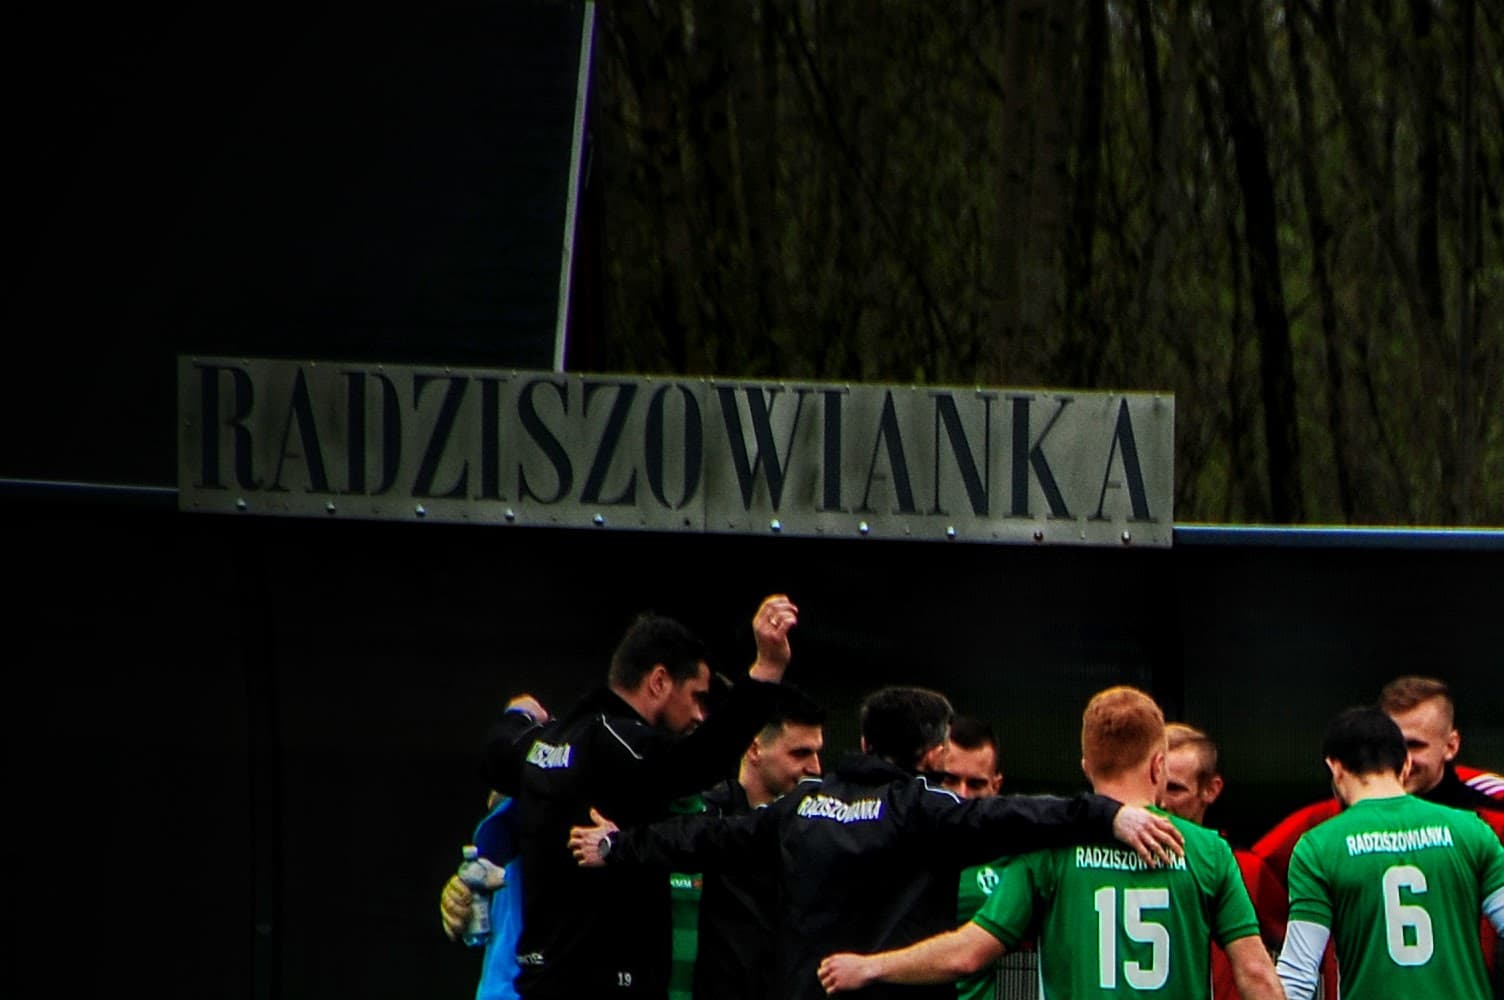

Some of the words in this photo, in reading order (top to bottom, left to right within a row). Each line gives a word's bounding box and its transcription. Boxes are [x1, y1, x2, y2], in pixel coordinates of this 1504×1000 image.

[191, 363, 1160, 523] RADZISZOWIANKA
[1345, 825, 1454, 857] RADZISZOWIANKA
[1094, 884, 1171, 991] 15
[1382, 864, 1434, 966] 6
